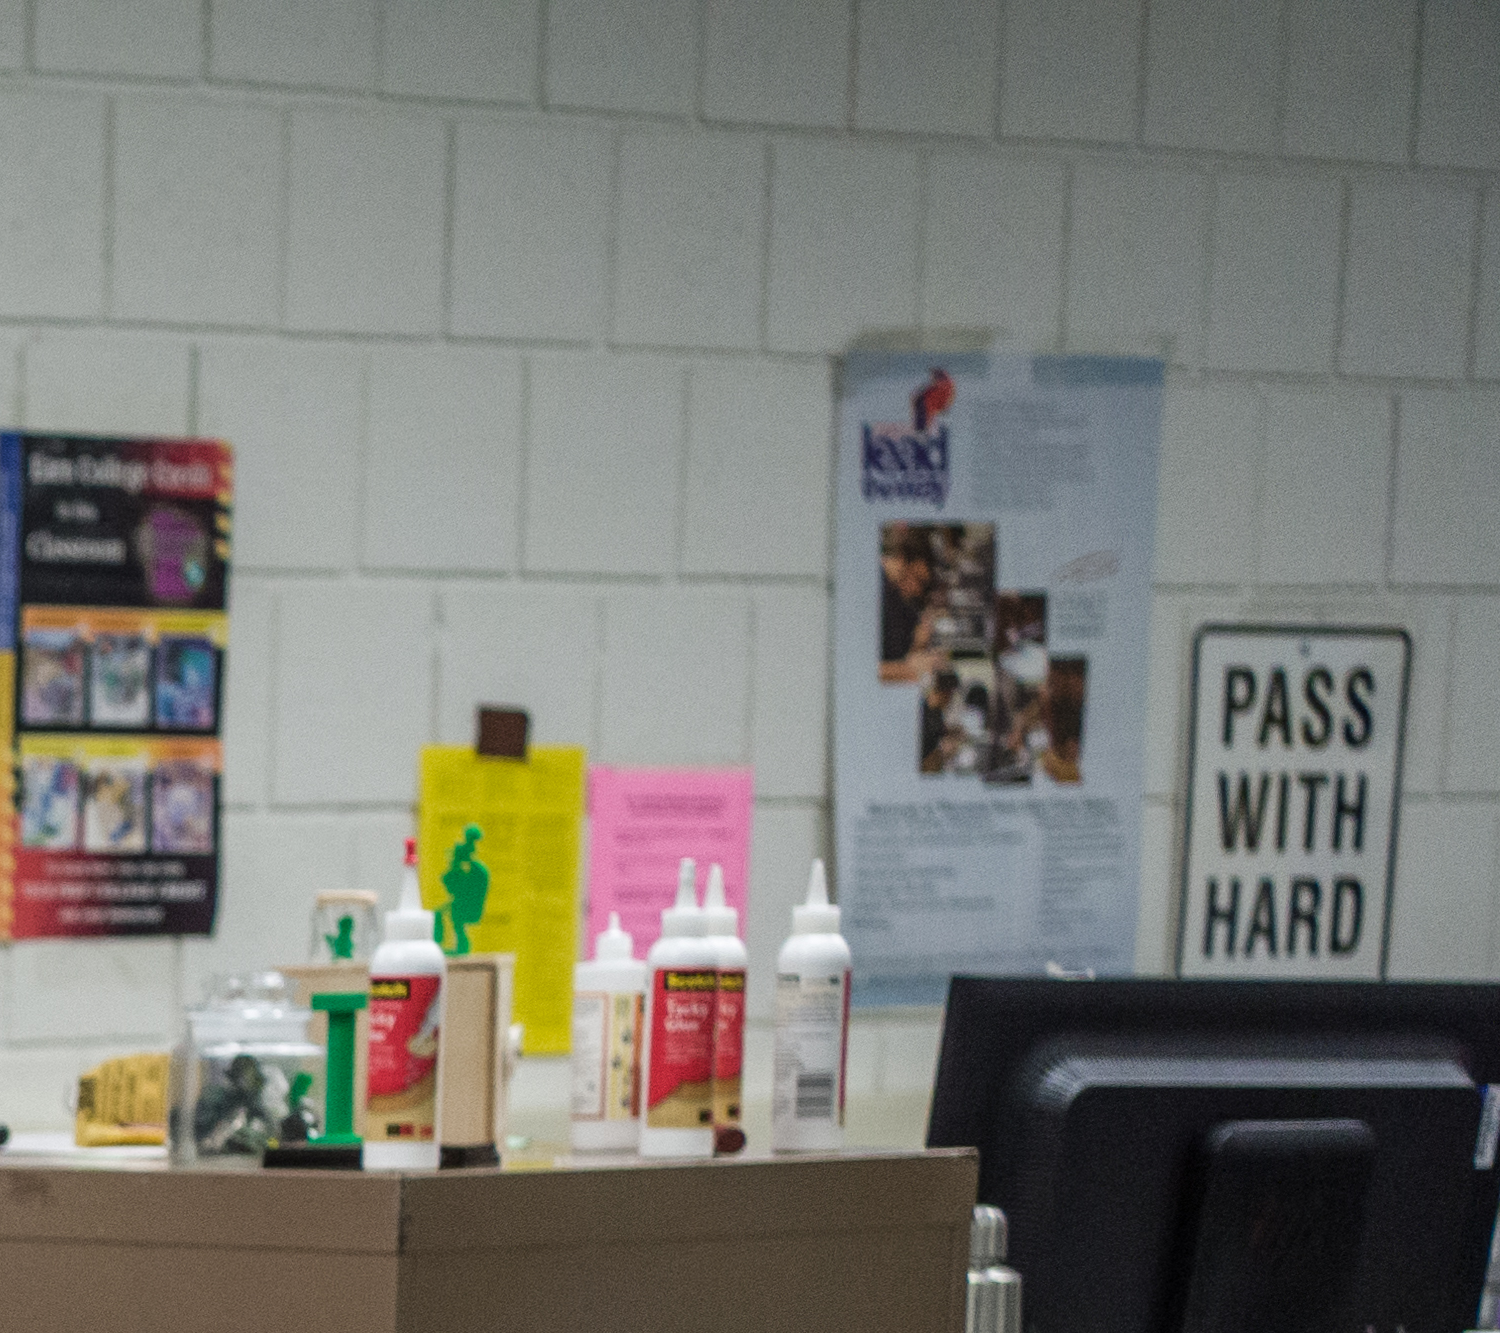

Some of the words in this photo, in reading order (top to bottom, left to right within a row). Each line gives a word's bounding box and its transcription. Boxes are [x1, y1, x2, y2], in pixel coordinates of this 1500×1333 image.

[1221, 664, 1376, 751] PASS
[1217, 769, 1370, 853] WITH
[1202, 873, 1365, 957] HARD
